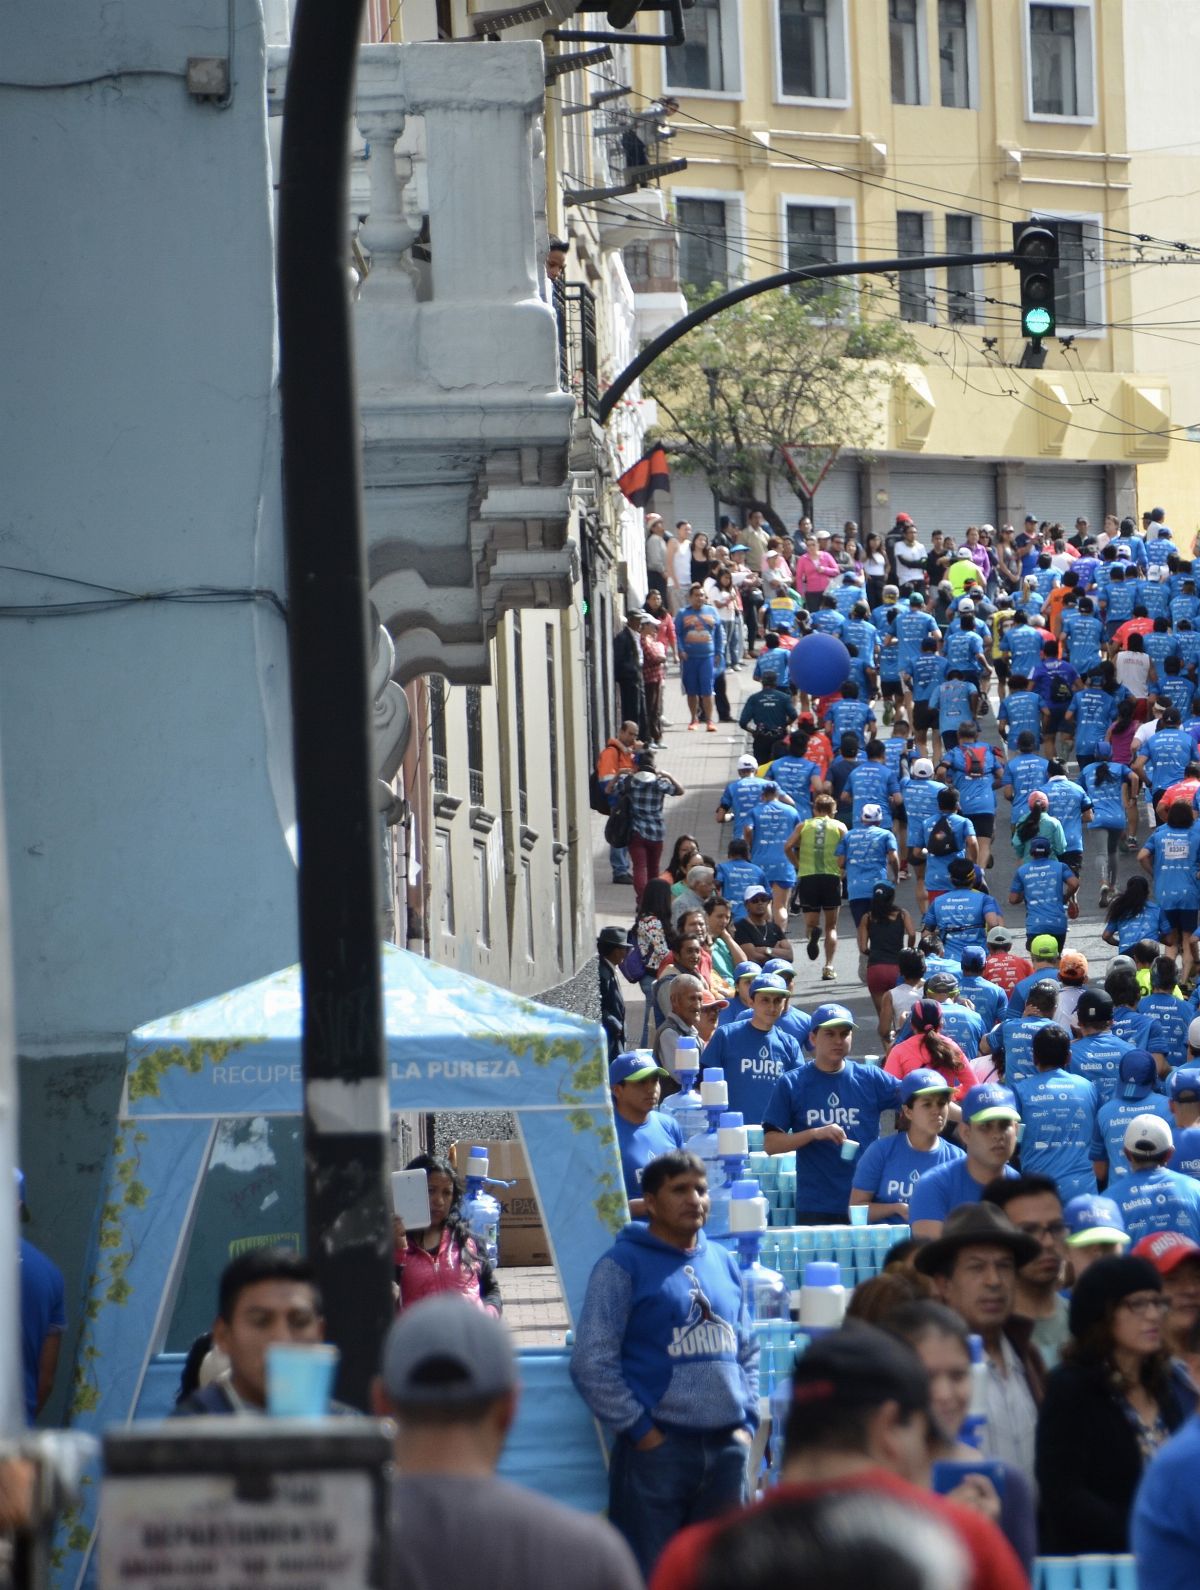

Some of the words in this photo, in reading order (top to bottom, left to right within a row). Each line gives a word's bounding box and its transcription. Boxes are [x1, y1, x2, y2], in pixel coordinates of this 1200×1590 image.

[212, 1064, 302, 1085] RECUPE
[391, 1061, 420, 1080] LA
[427, 1060, 521, 1079] PUREZA
[741, 1058, 784, 1076] PURE
[978, 1090, 1005, 1102] PURE
[806, 1107, 860, 1126] PURE
[887, 1179, 914, 1197] PU
